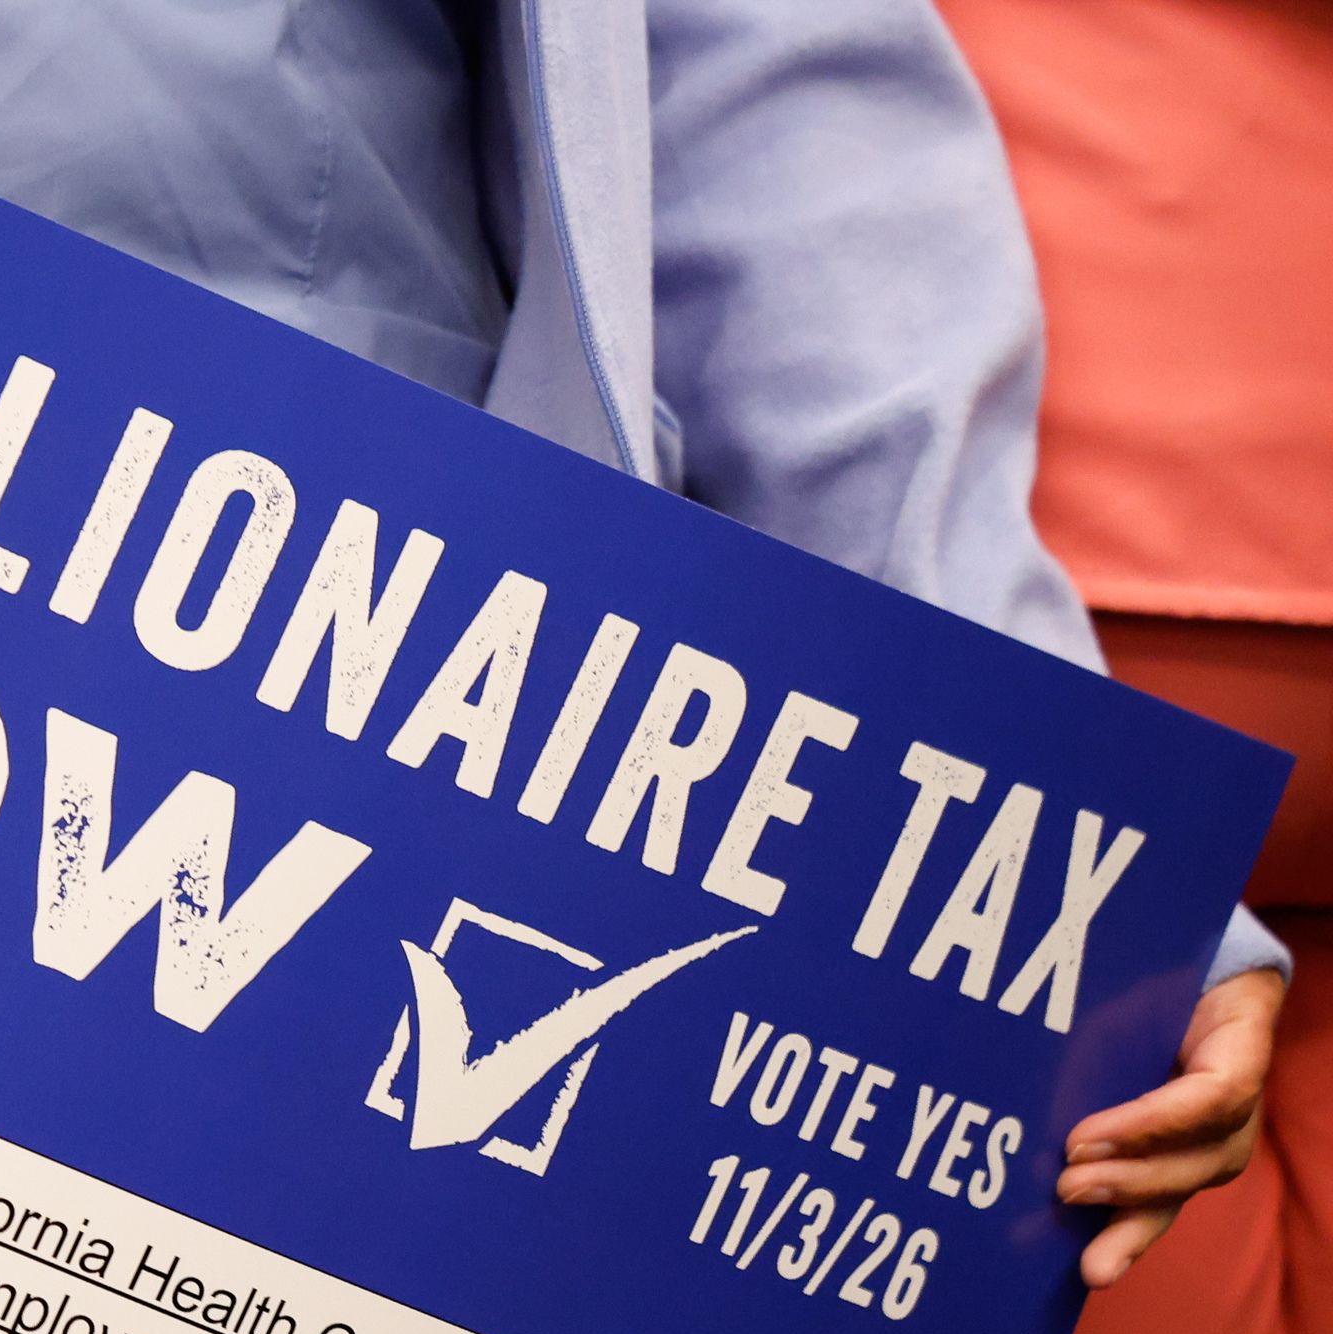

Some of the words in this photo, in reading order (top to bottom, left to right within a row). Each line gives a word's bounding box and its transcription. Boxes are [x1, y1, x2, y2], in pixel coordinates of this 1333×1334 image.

[851, 740, 1147, 1034] TAX
[708, 1011, 897, 1160] VOTE
[896, 1084, 1024, 1209] YES
[689, 1155, 939, 1321] 11/3/26
